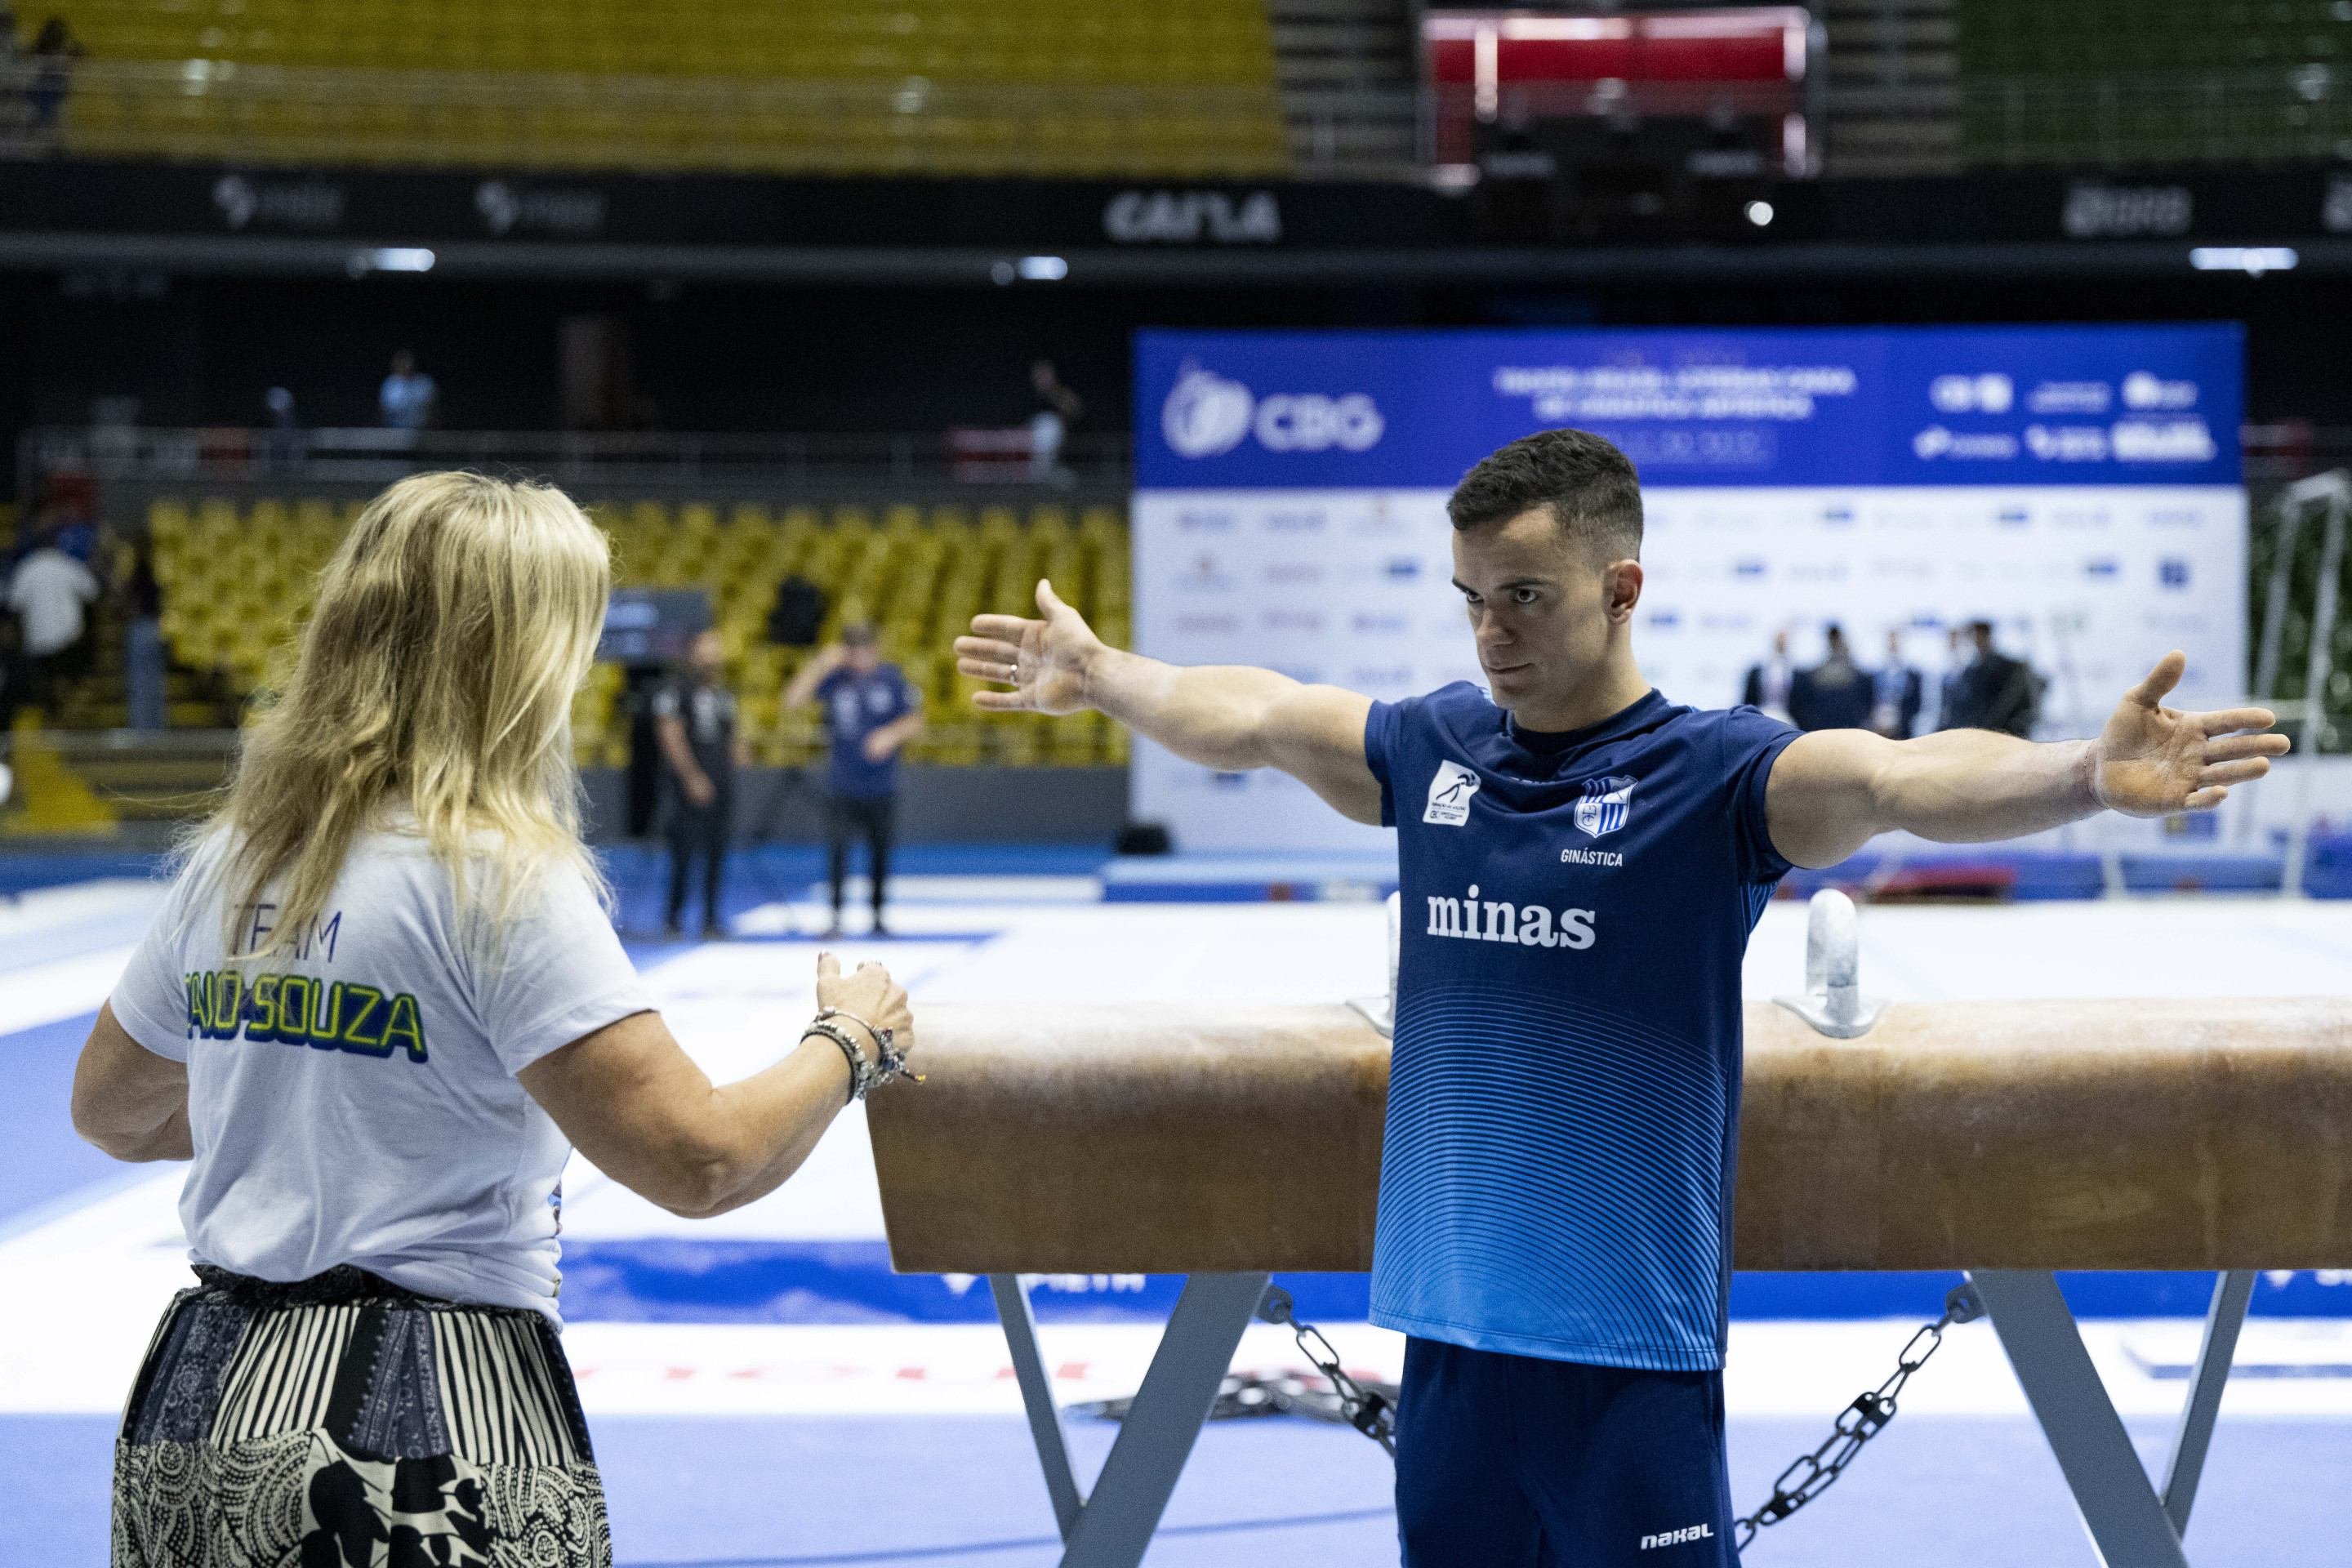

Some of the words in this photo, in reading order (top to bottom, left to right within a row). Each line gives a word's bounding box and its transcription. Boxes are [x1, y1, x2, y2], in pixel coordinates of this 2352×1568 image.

[1561, 847, 1624, 867] GINÁSTICA
[1427, 884, 1596, 950] minas
[246, 973, 429, 1064] SOUZA
